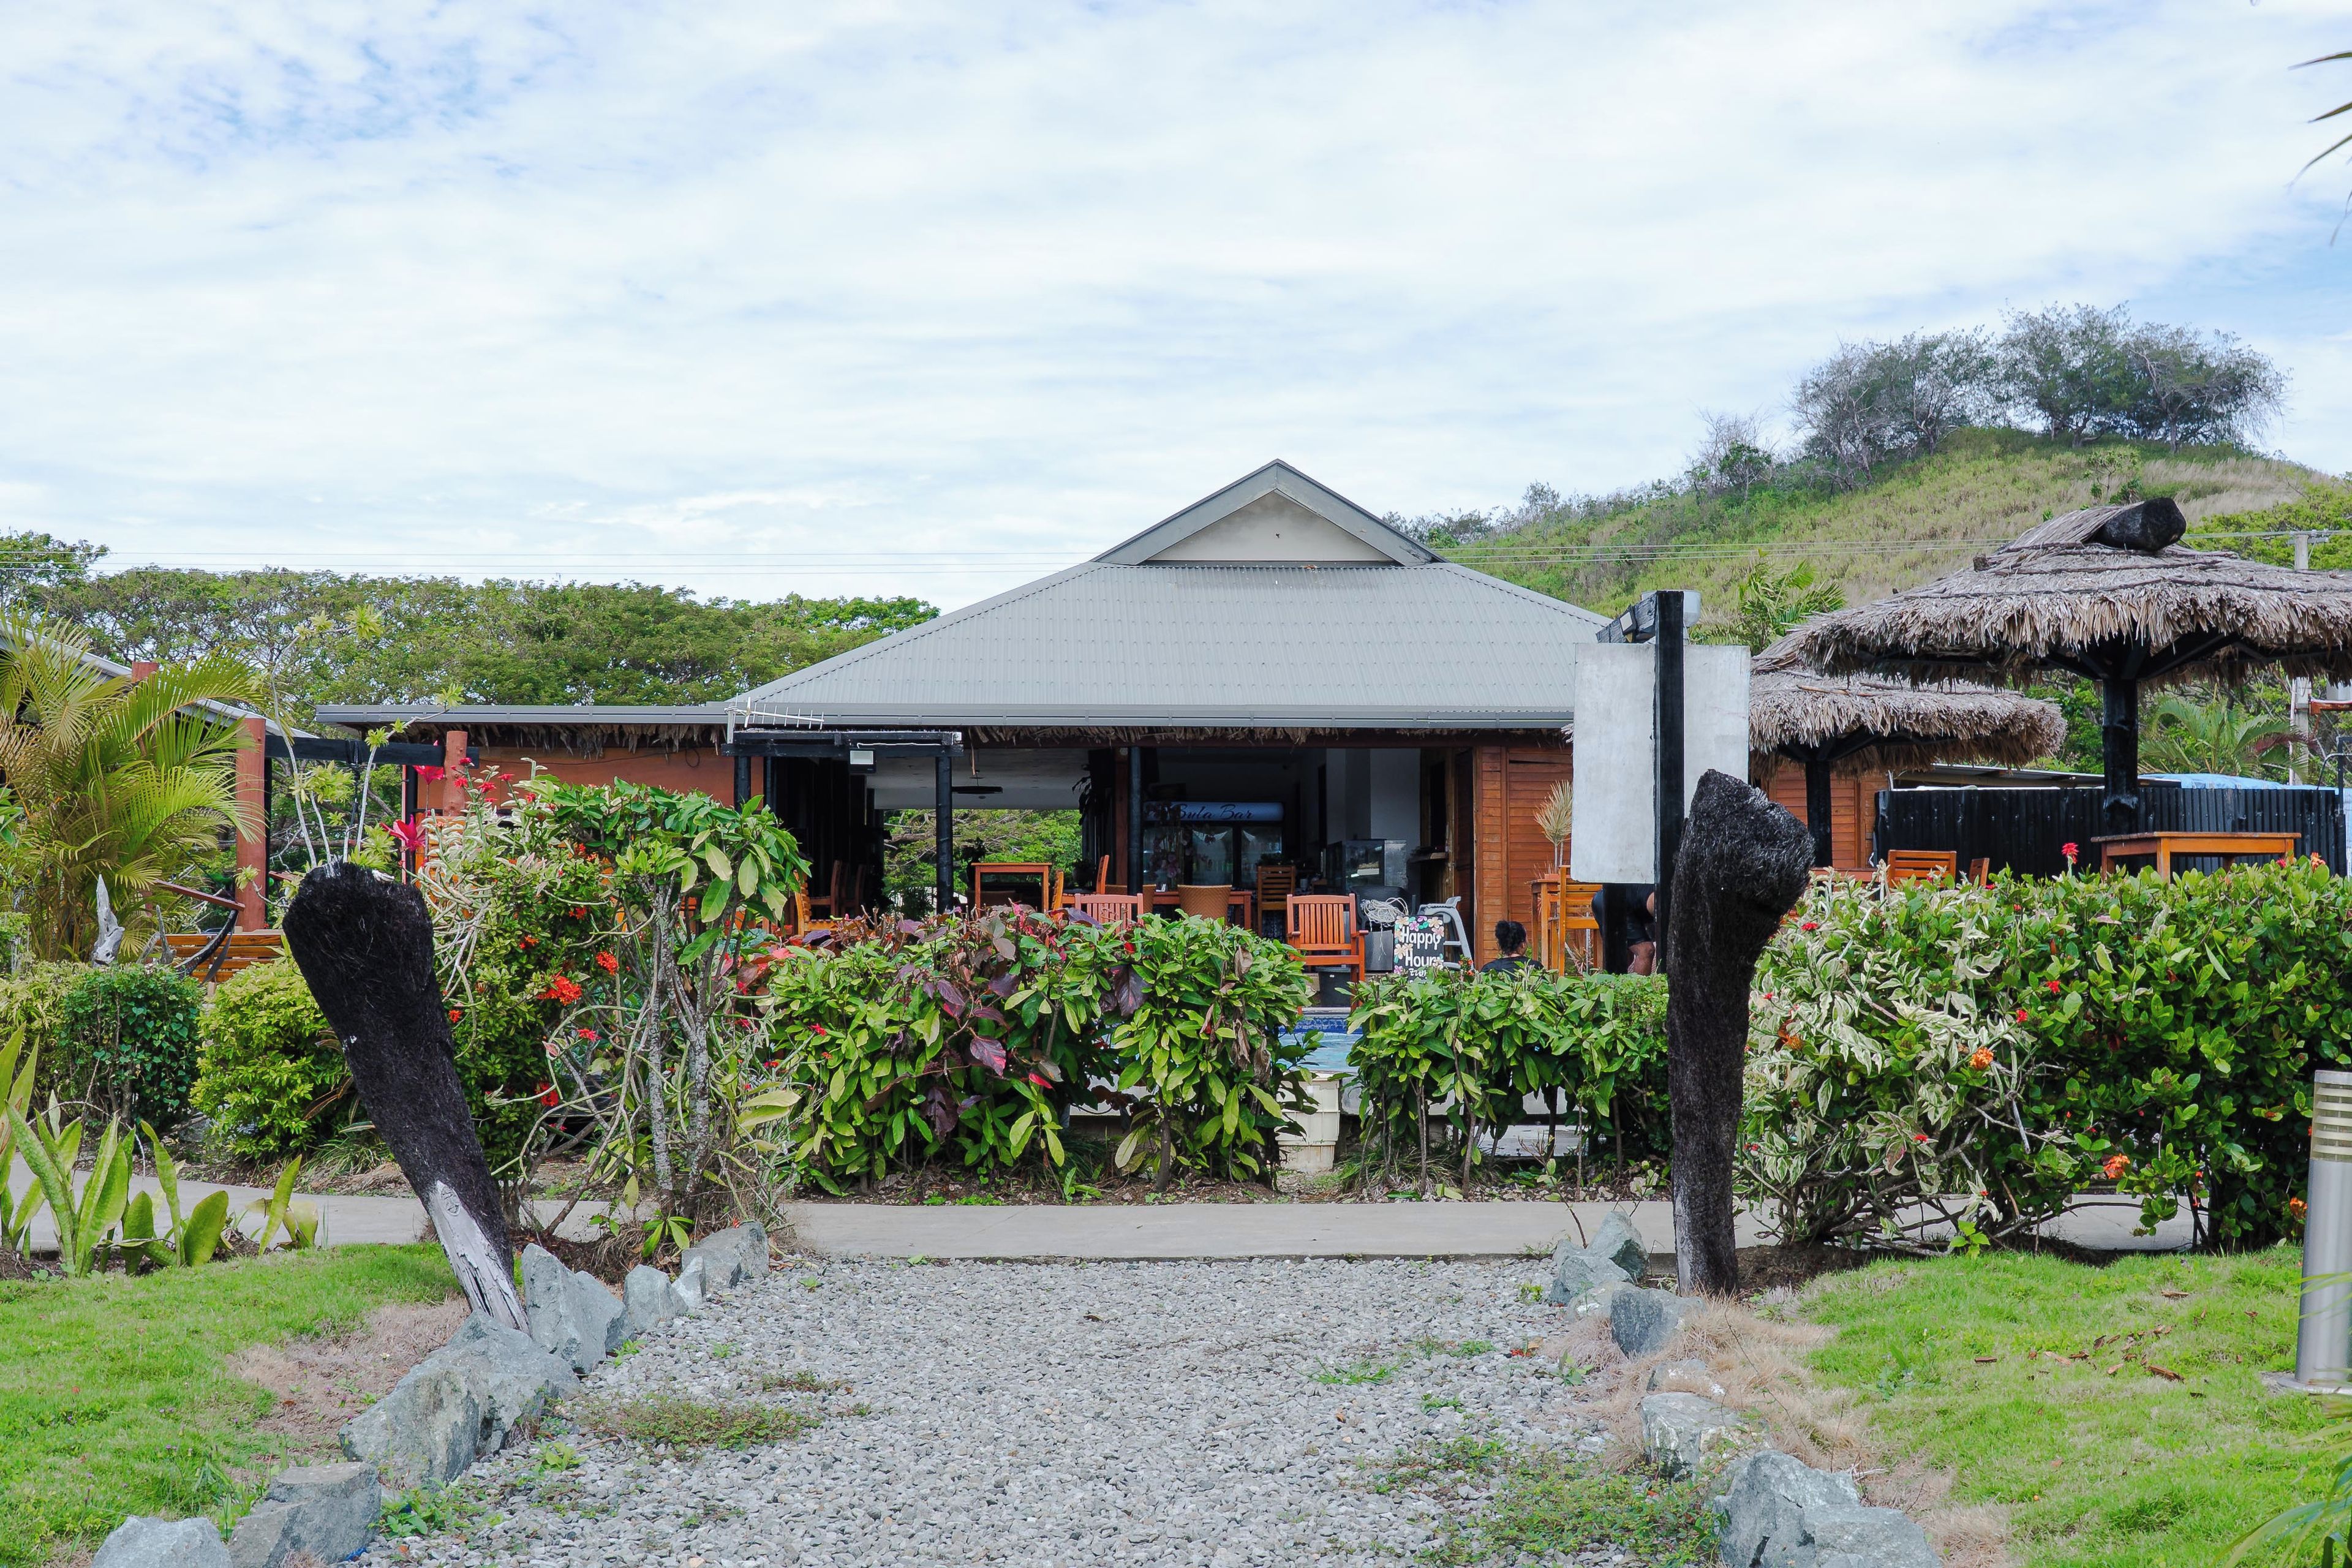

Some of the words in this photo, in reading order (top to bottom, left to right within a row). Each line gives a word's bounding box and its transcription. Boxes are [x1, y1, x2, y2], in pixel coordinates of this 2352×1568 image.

[1178, 803, 1215, 820] Bula
[1220, 804, 1254, 820] Bar
[1401, 925, 1441, 950] Happy
